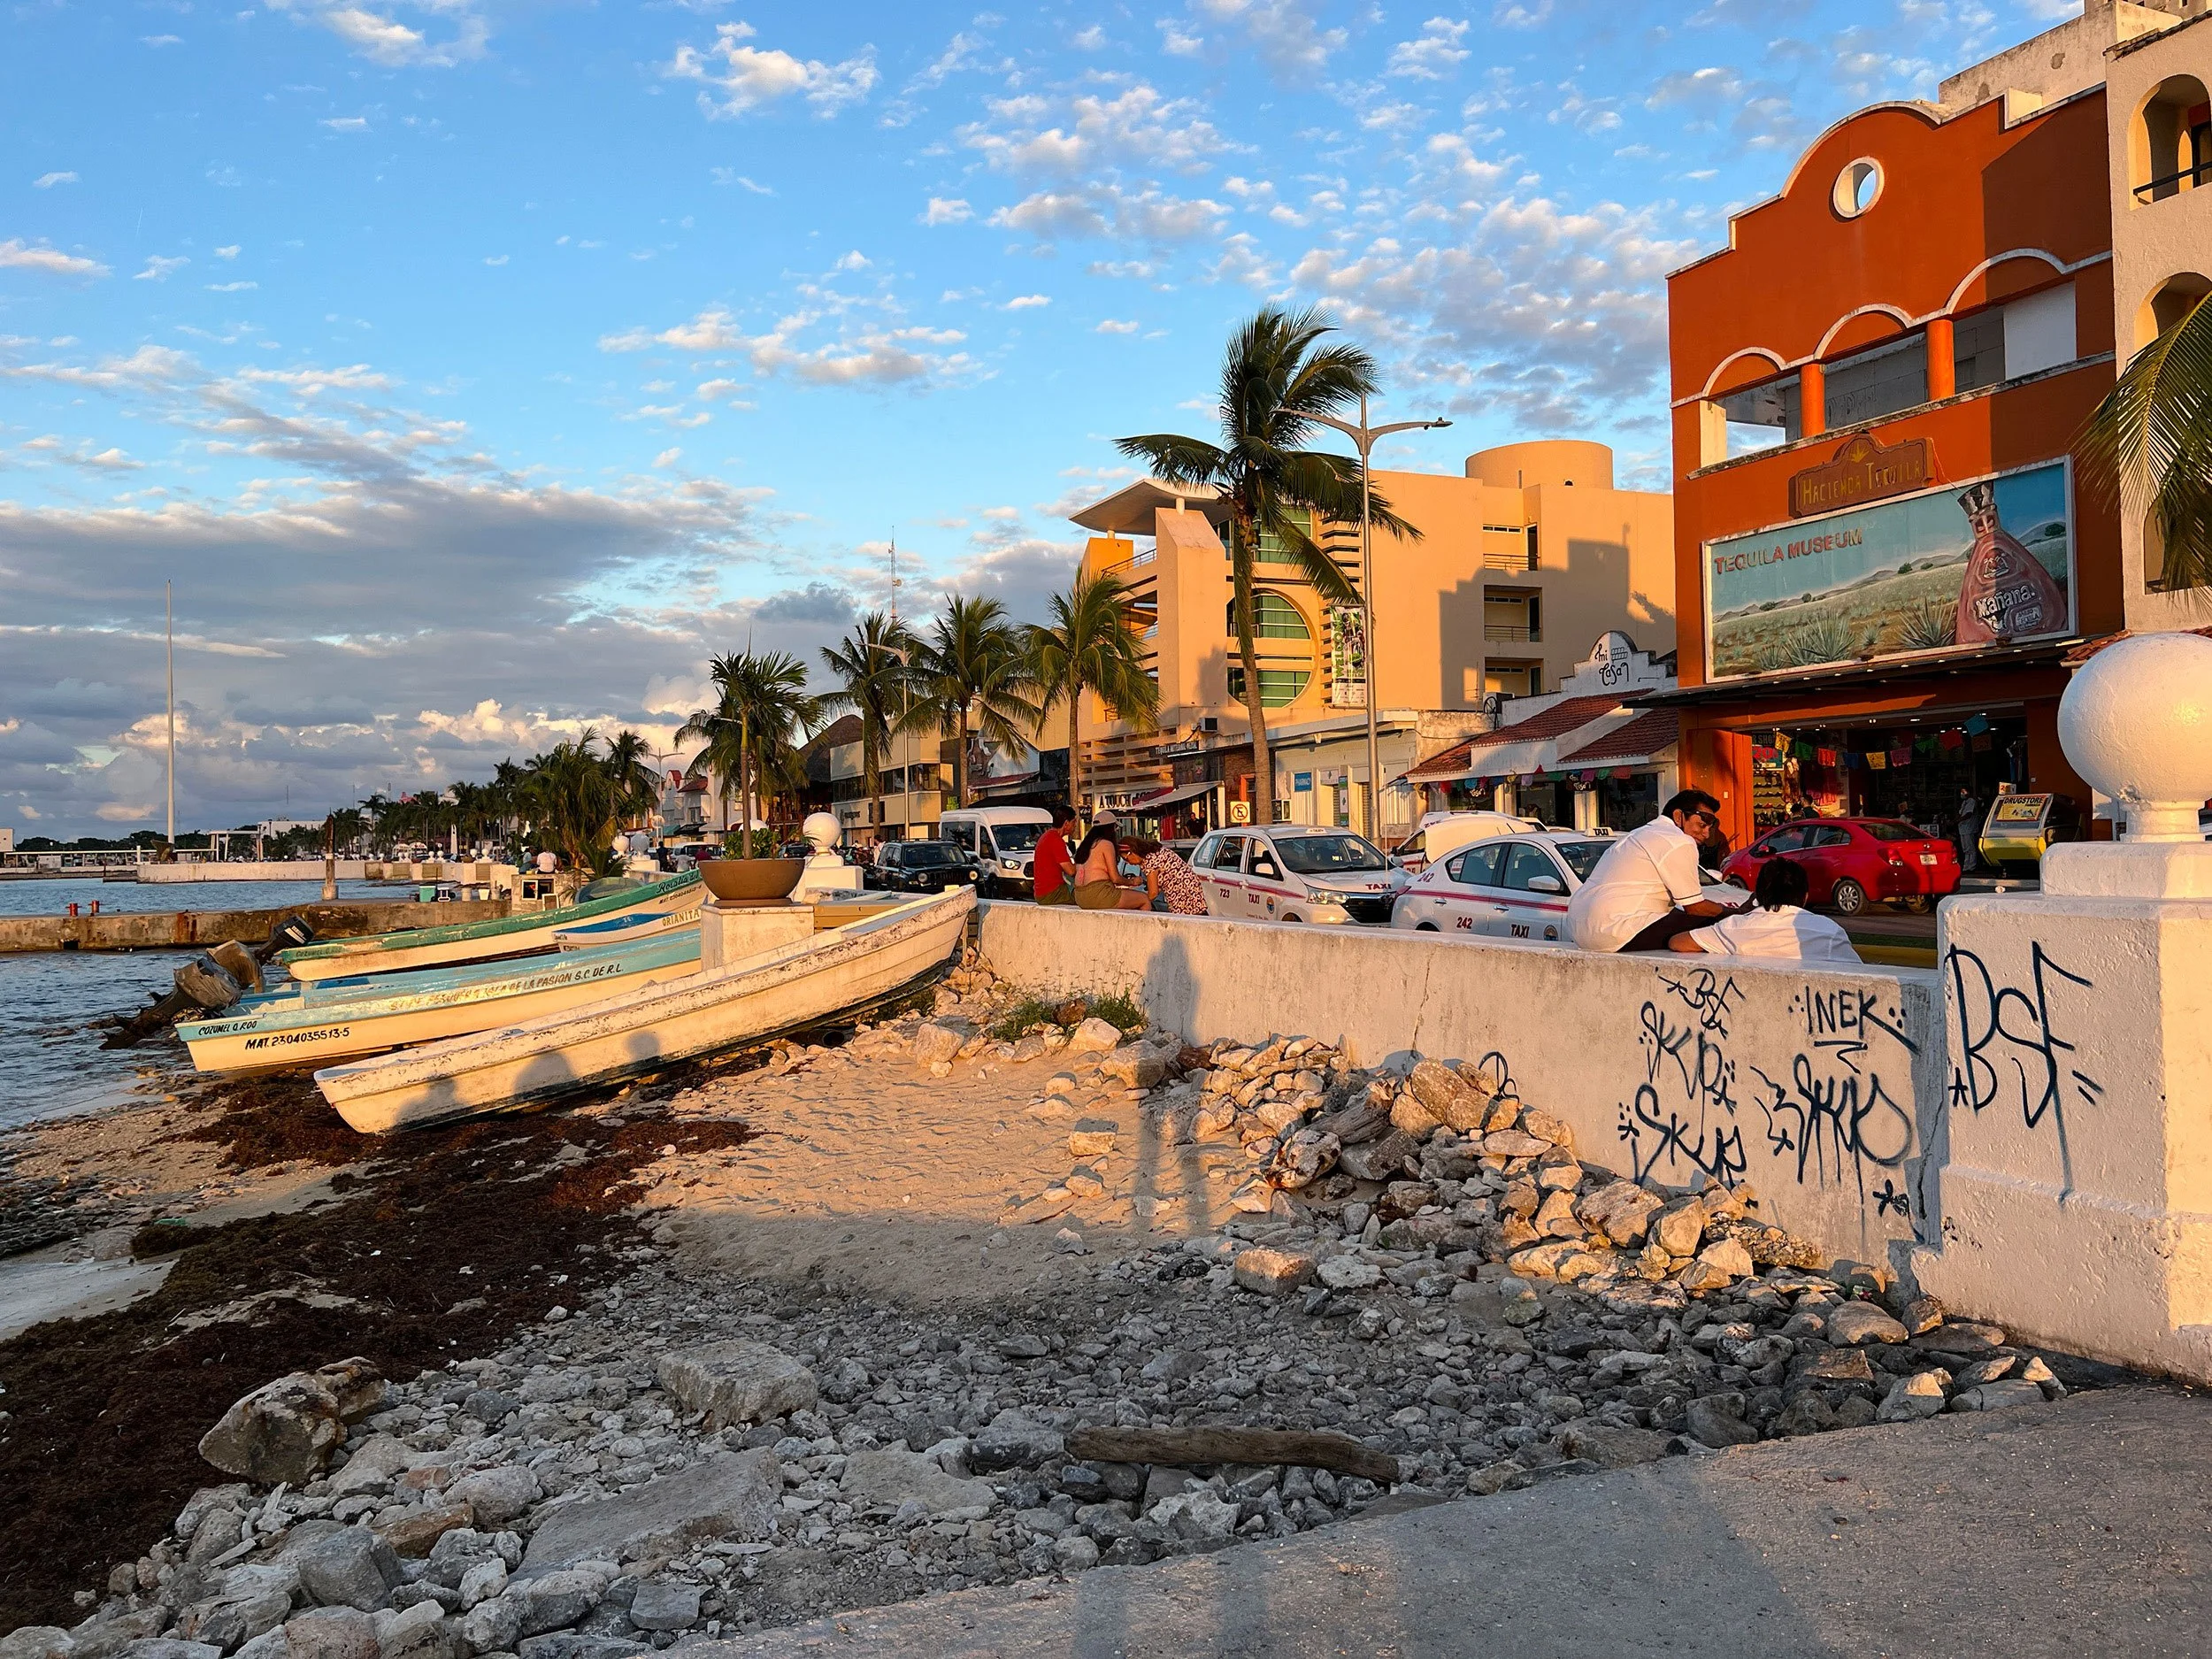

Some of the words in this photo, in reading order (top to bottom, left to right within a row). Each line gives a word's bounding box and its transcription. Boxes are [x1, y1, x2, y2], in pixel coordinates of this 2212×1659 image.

[1865, 459, 1921, 490] TEQUILA
[1715, 545, 1784, 574] TEQUILA
[1787, 527, 1863, 559] MUSEUM
[1099, 795, 1105, 809] A
[1105, 794, 1132, 808] TOUCH
[1219, 888, 1230, 899] 723
[1248, 894, 1260, 904] TAXI
[663, 910, 700, 926] ORIANITA
[1456, 917, 1472, 929] 242
[1511, 925, 1530, 938] TAXI
[536, 972, 572, 987] PASION
[592, 965, 605, 978] DE
[606, 964, 624, 974] R.L.
[198, 1024, 230, 1035] COZUMEL
[271, 1026, 350, 1047] 2304035513-5
